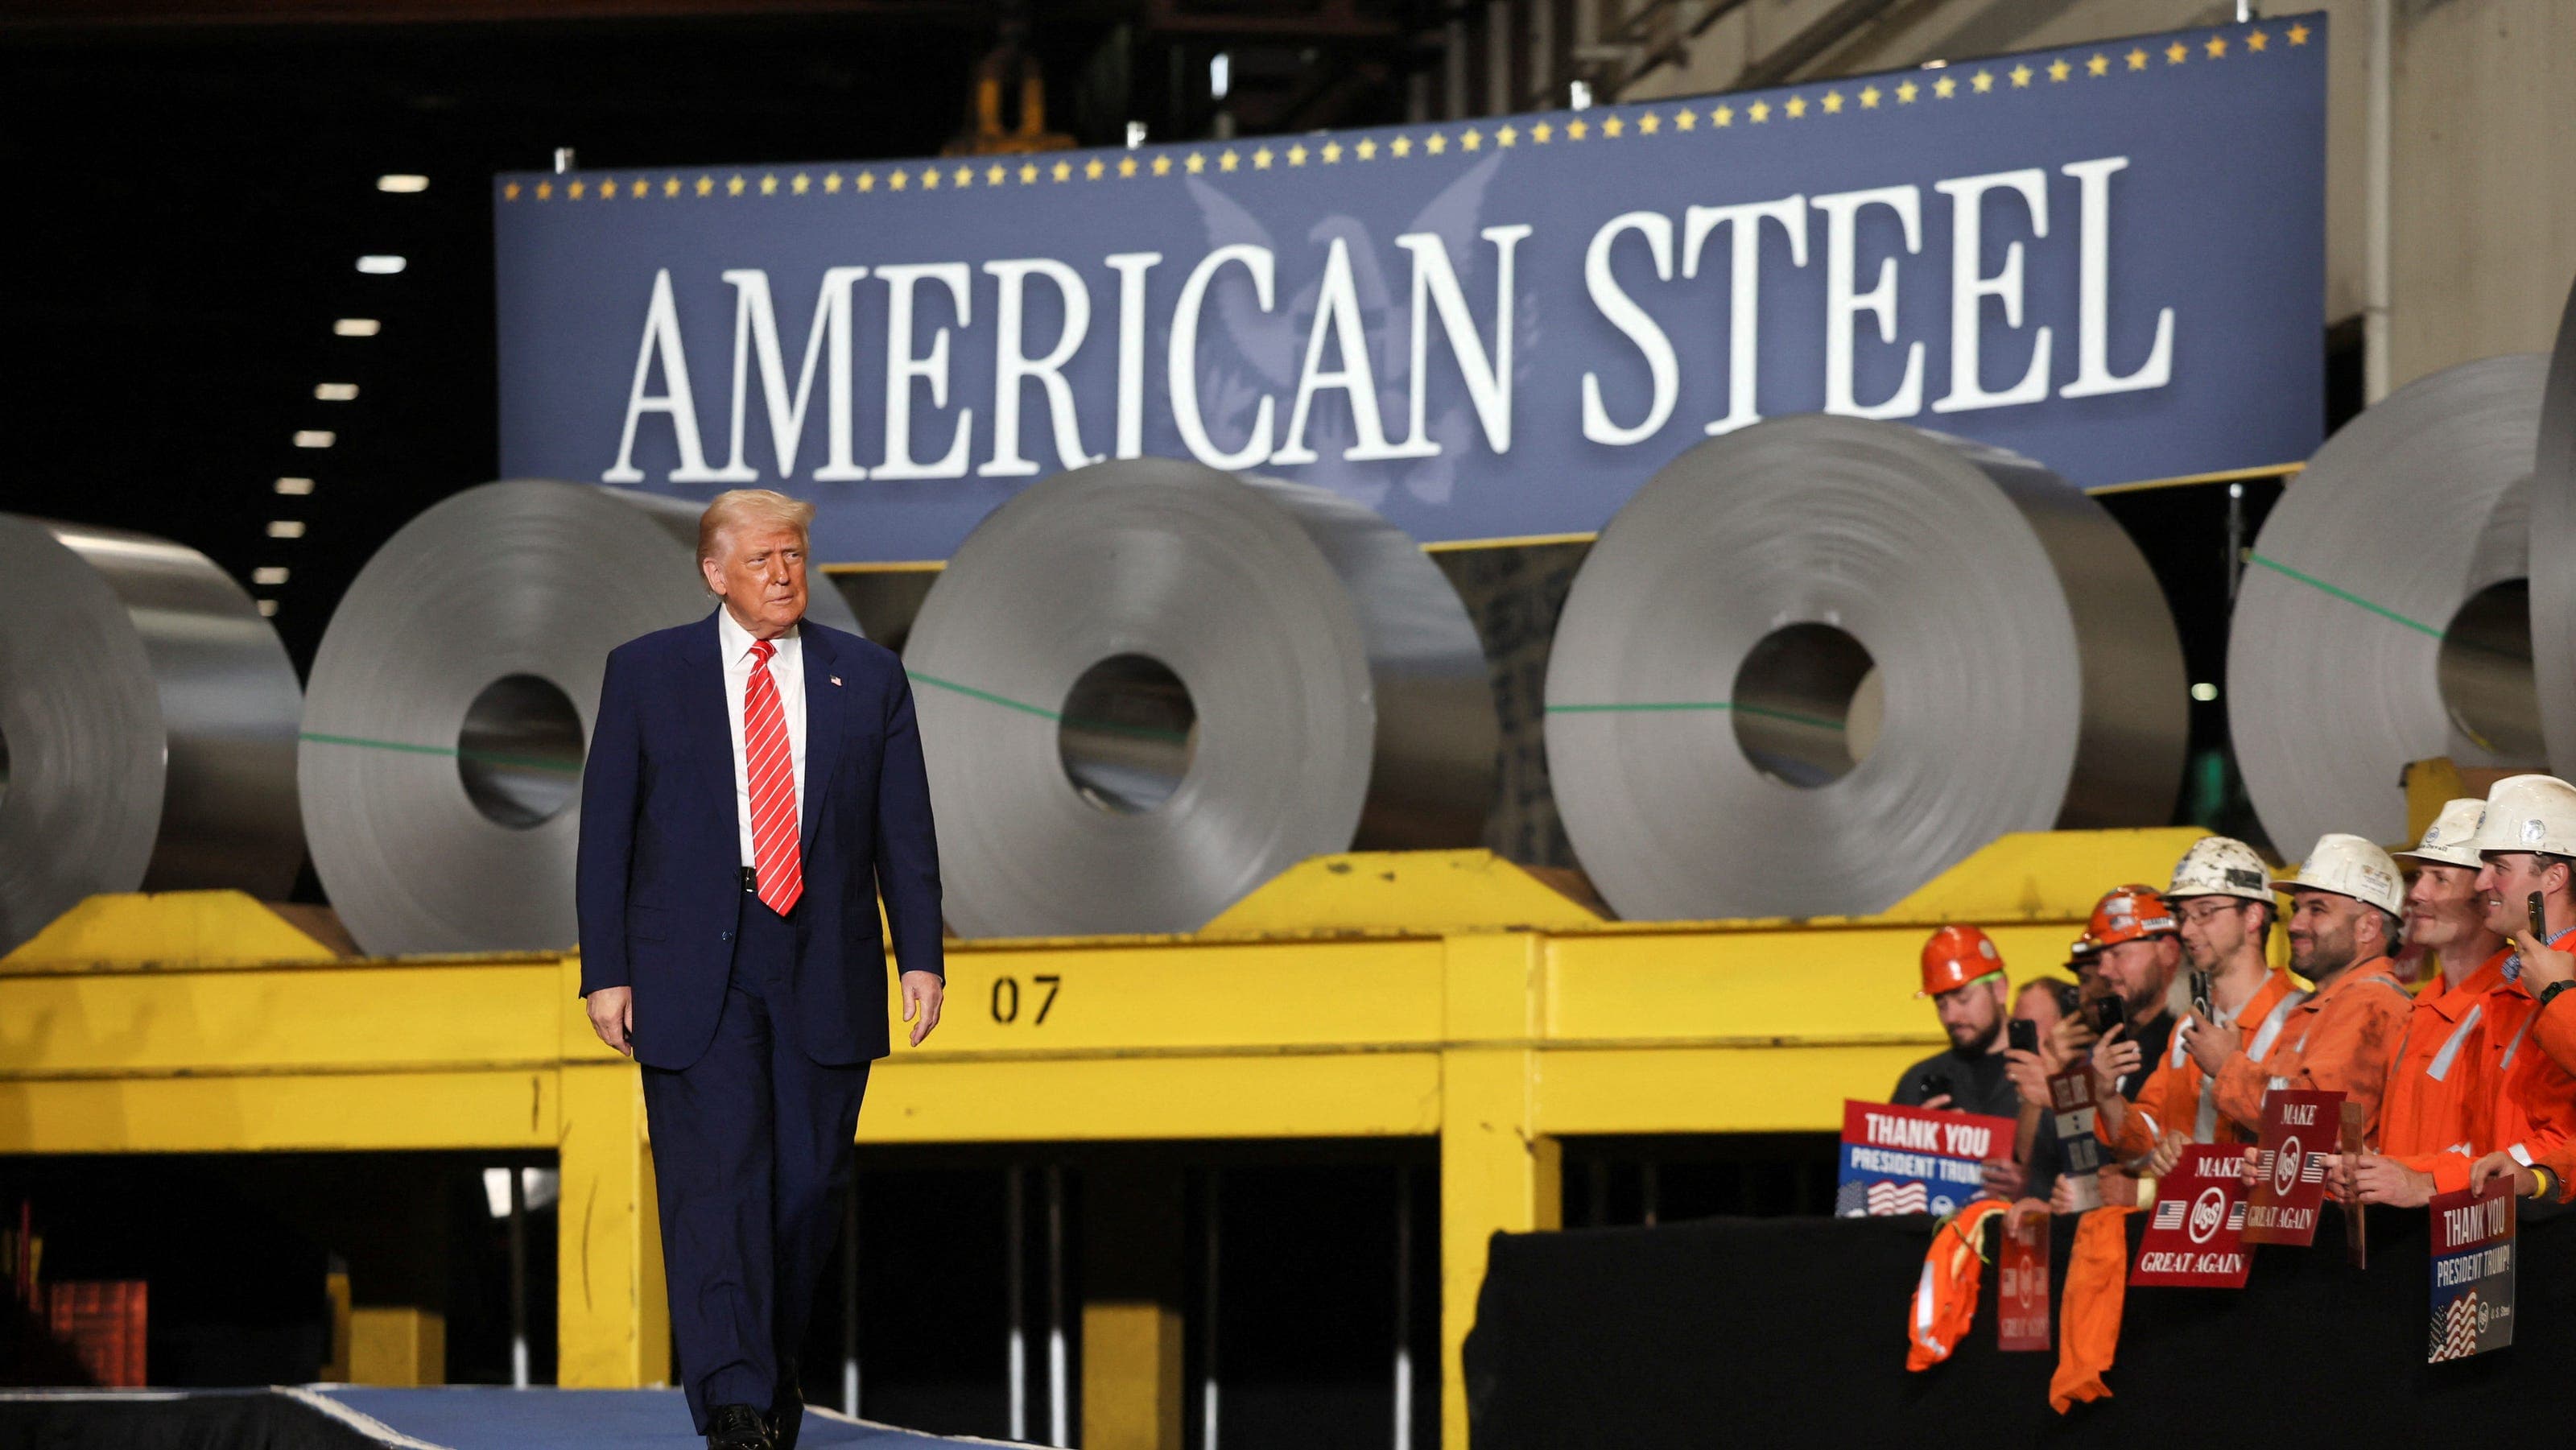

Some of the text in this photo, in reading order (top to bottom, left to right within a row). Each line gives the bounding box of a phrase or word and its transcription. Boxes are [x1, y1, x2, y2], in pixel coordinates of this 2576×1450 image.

[602, 156, 2174, 482] AMERICAN STEEL
[991, 975, 1060, 1025] 07
[1864, 1113, 1992, 1158] THANK YOU
[2280, 1104, 2318, 1126] MAKE
[1851, 1146, 1983, 1185] PRESIDENT TRUM
[2194, 1157, 2245, 1177] MAKE
[2248, 1206, 2314, 1229] GREAT AGAIN
[2443, 1196, 2506, 1247] THANK YOU
[2140, 1252, 2245, 1274] GREAT AGAIN
[2437, 1244, 2510, 1287] PRESIDENT TRUMP!
